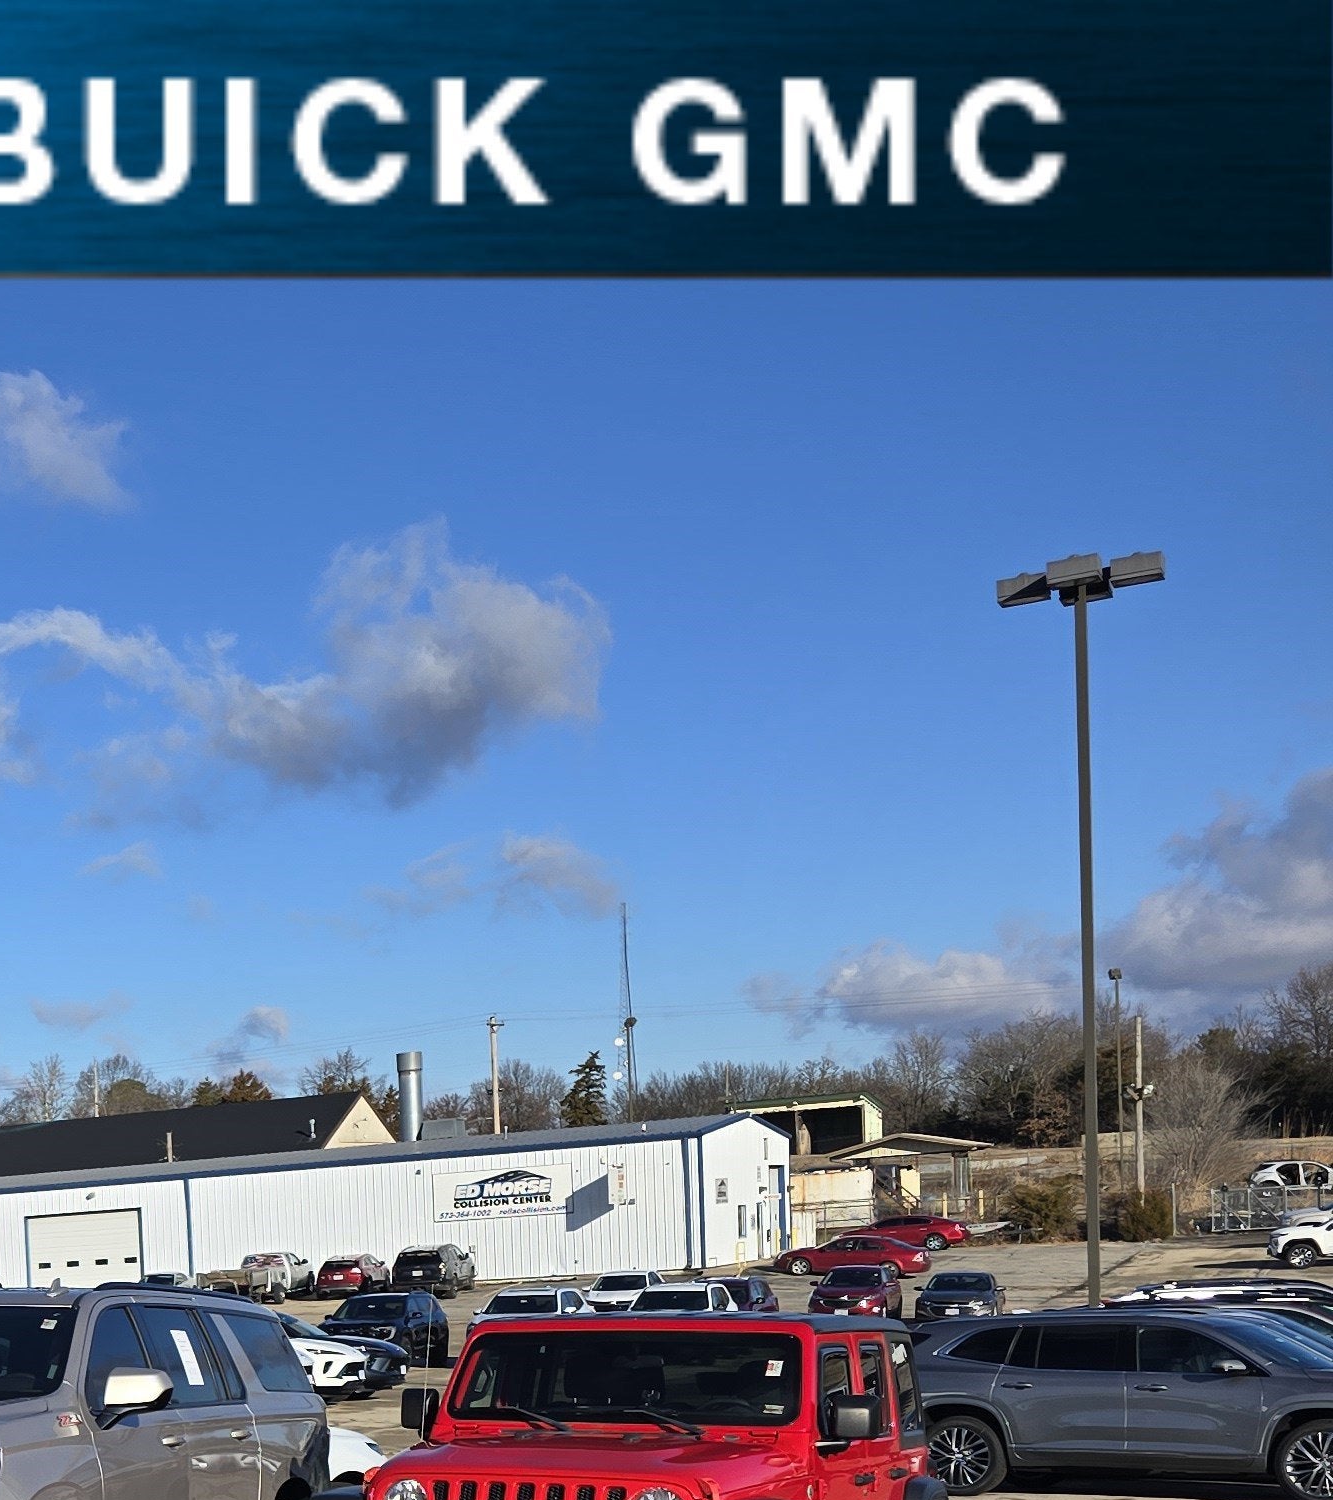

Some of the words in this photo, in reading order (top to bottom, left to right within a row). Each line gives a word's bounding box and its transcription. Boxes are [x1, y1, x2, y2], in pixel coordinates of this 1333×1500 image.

[454, 1184, 482, 1200] ED
[482, 1178, 552, 1199] MORSE
[454, 1198, 509, 1209] COLLISION
[513, 1194, 552, 1205] CENTER
